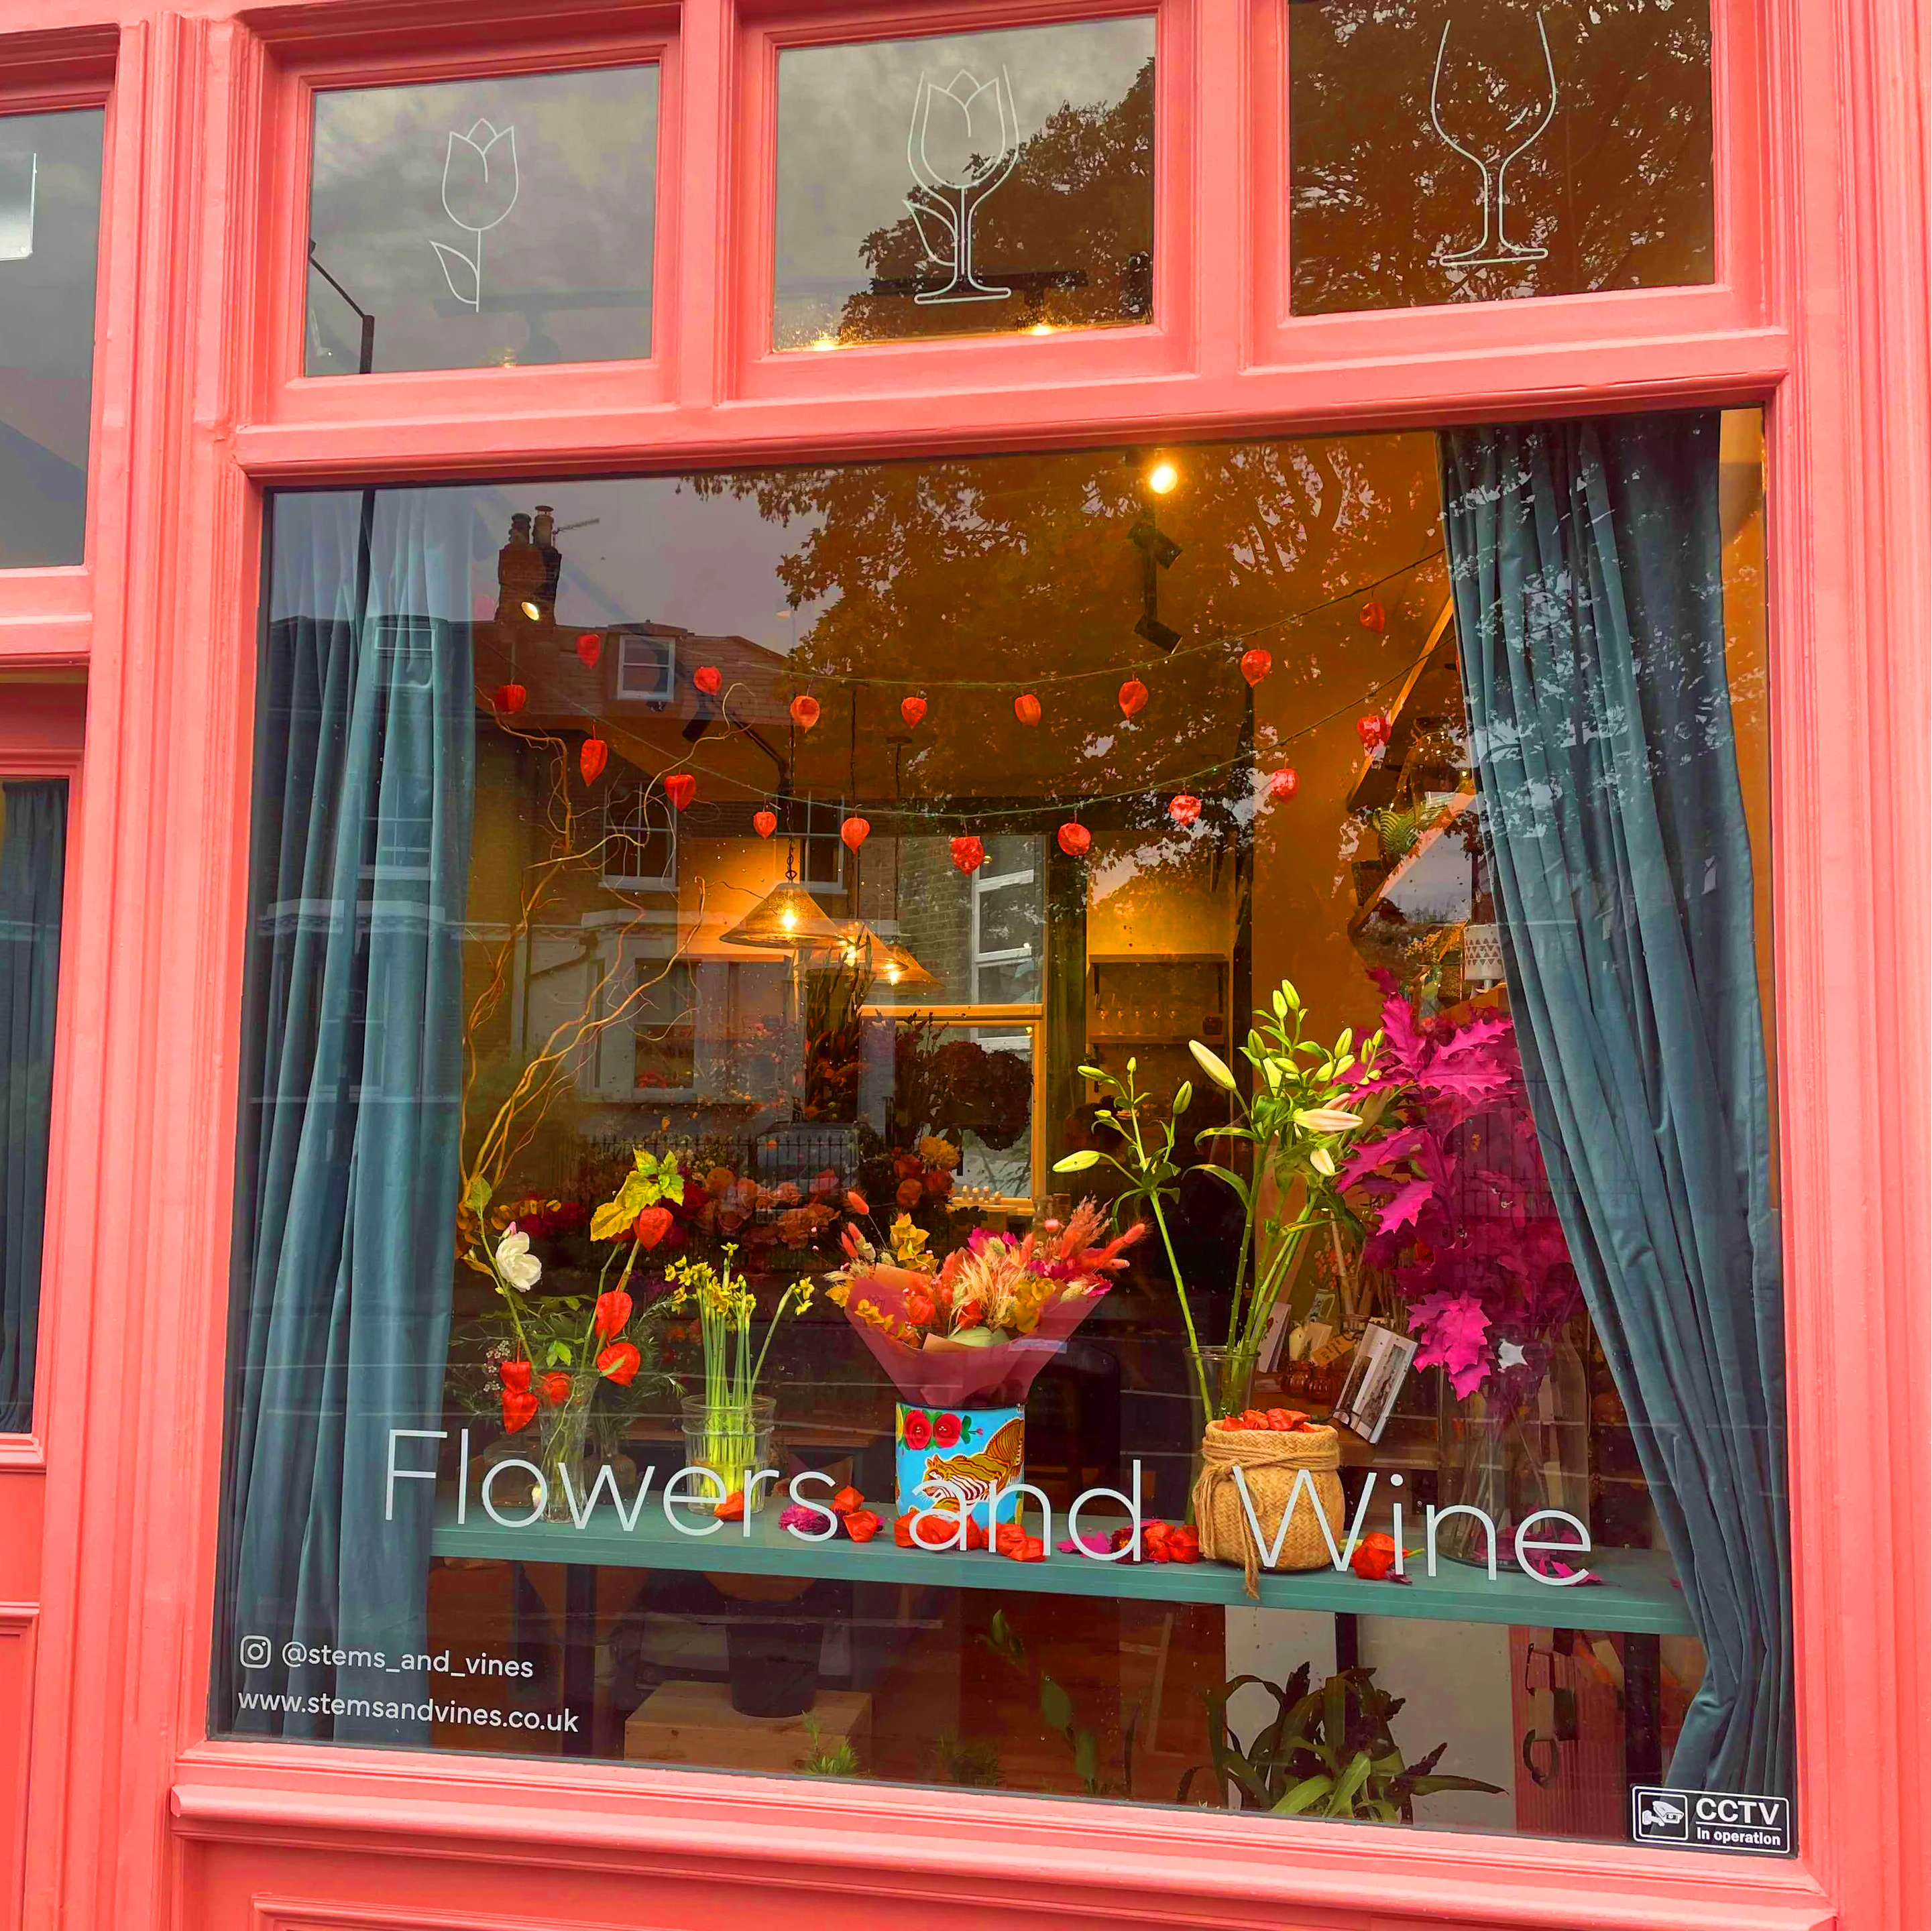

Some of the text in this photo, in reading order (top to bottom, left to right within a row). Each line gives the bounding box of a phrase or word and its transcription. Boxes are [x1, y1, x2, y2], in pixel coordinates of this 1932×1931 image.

[384, 1428, 1592, 1586] Flowers and Wine
[281, 1641, 534, 1678] @stems_and_vines
[237, 1692, 579, 1733] www.stemsandvines.co.uk
[1696, 1798, 1780, 1825] CCTV
[1713, 1830, 1781, 1846] operation
